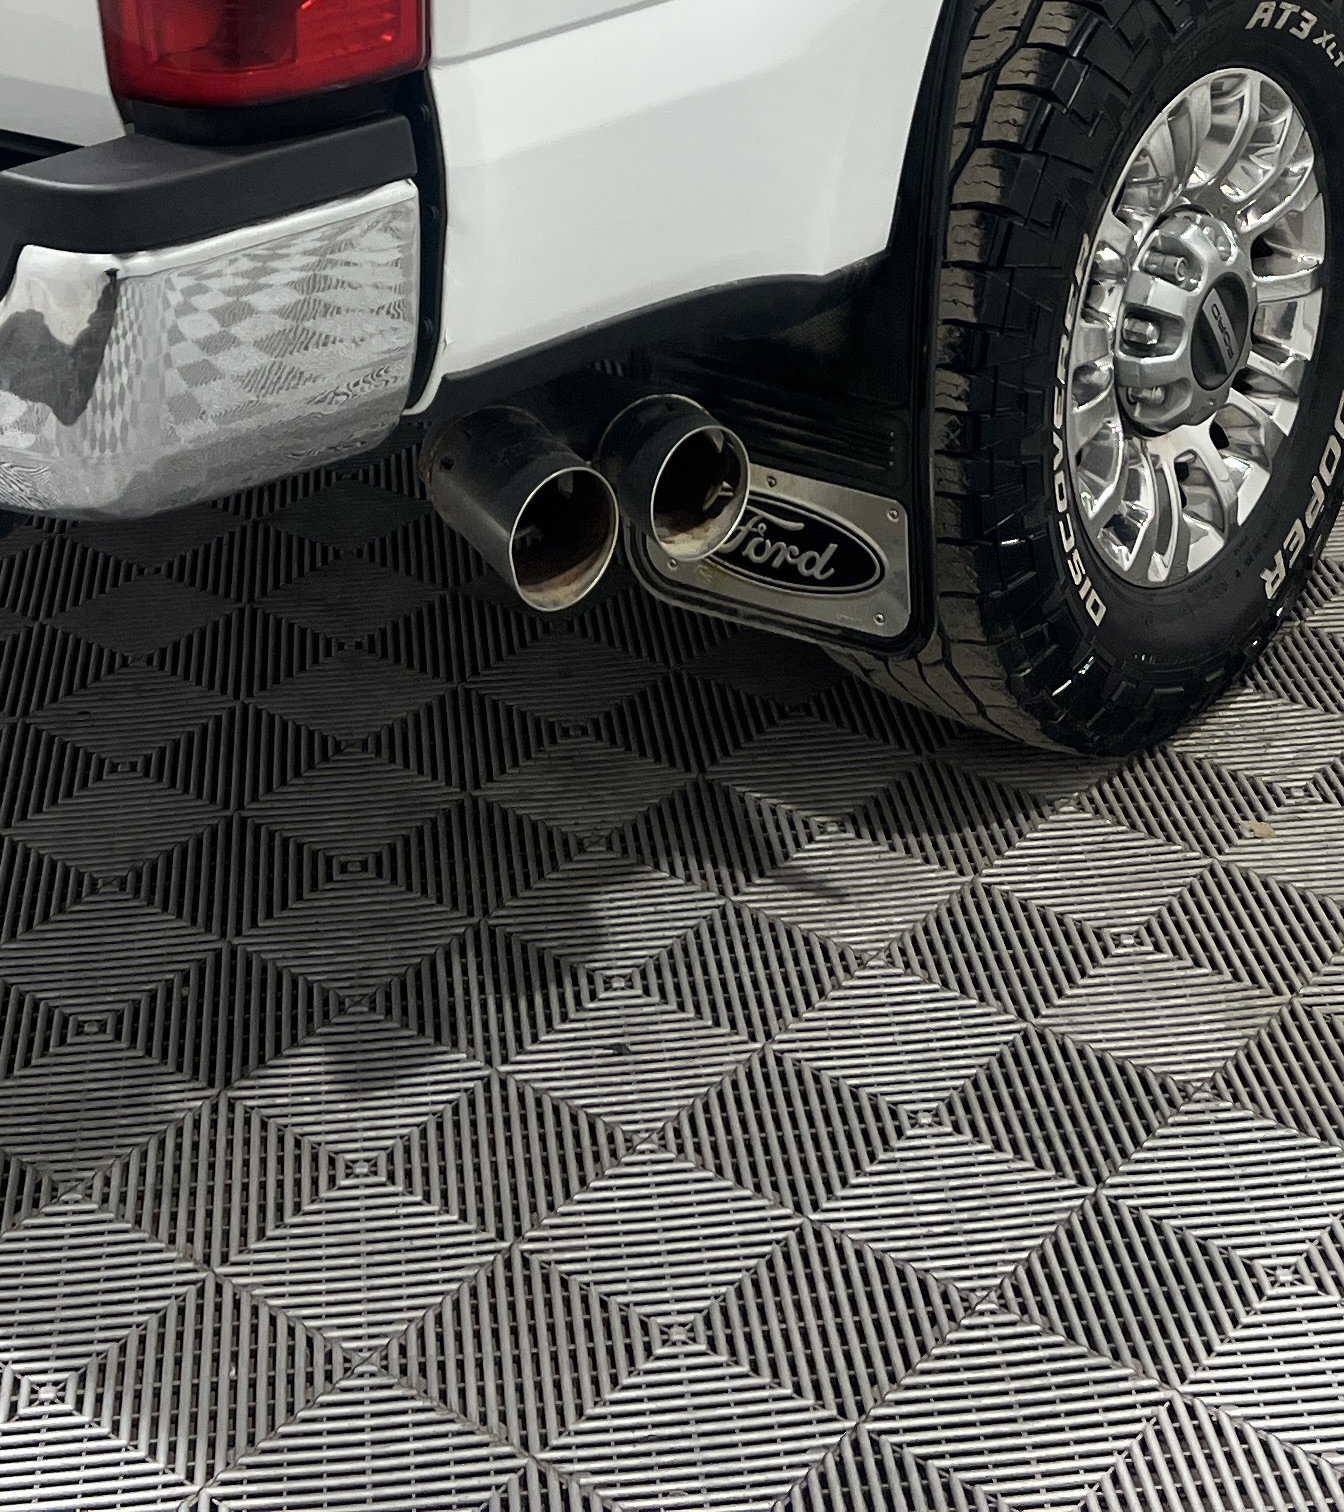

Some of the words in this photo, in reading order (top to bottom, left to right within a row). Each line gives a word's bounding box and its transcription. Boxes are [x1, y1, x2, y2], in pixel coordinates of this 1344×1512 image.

[1244, 0, 1318, 41] AT3
[1211, 303, 1235, 360] FORD
[1053, 231, 1107, 627] DISCOVERER
[718, 504, 839, 580] Ford
